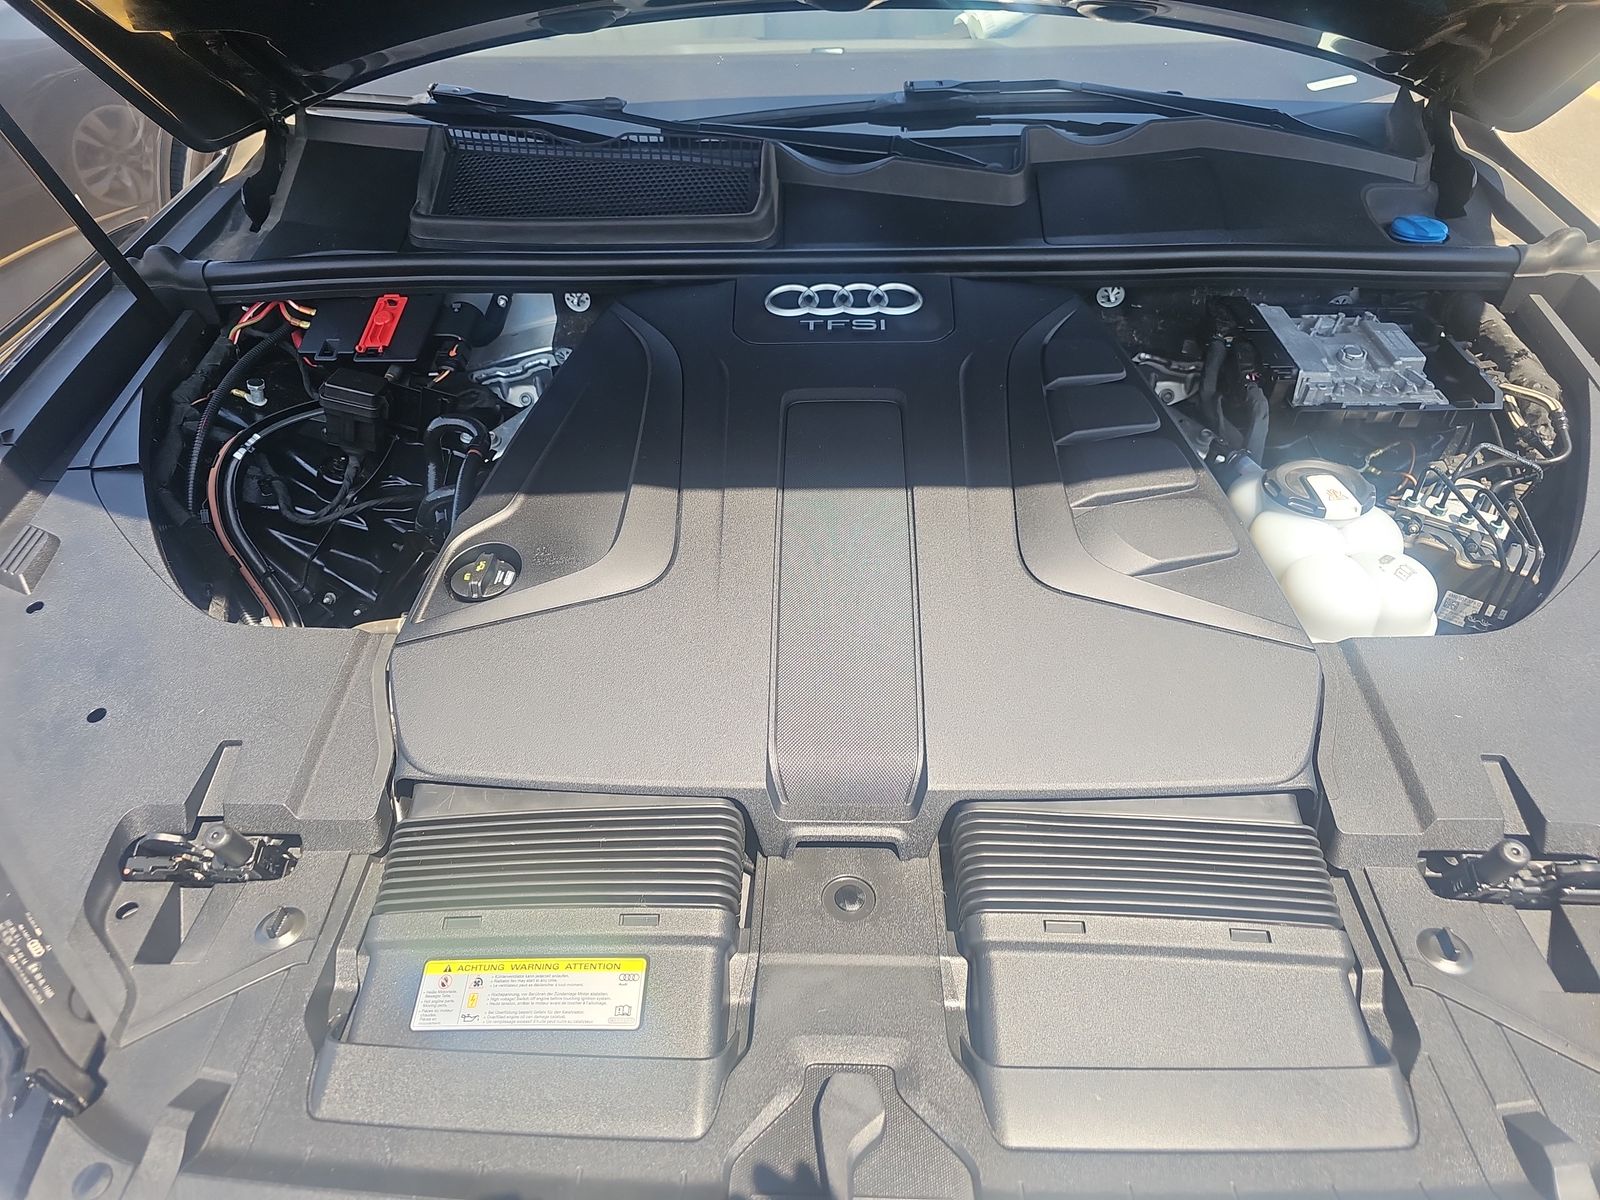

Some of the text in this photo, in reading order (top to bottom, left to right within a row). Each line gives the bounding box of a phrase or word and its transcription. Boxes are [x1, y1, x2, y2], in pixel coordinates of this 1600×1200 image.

[799, 319, 886, 331] TFSI
[457, 962, 621, 972] ACHTUNG WARNING ATTENTION
